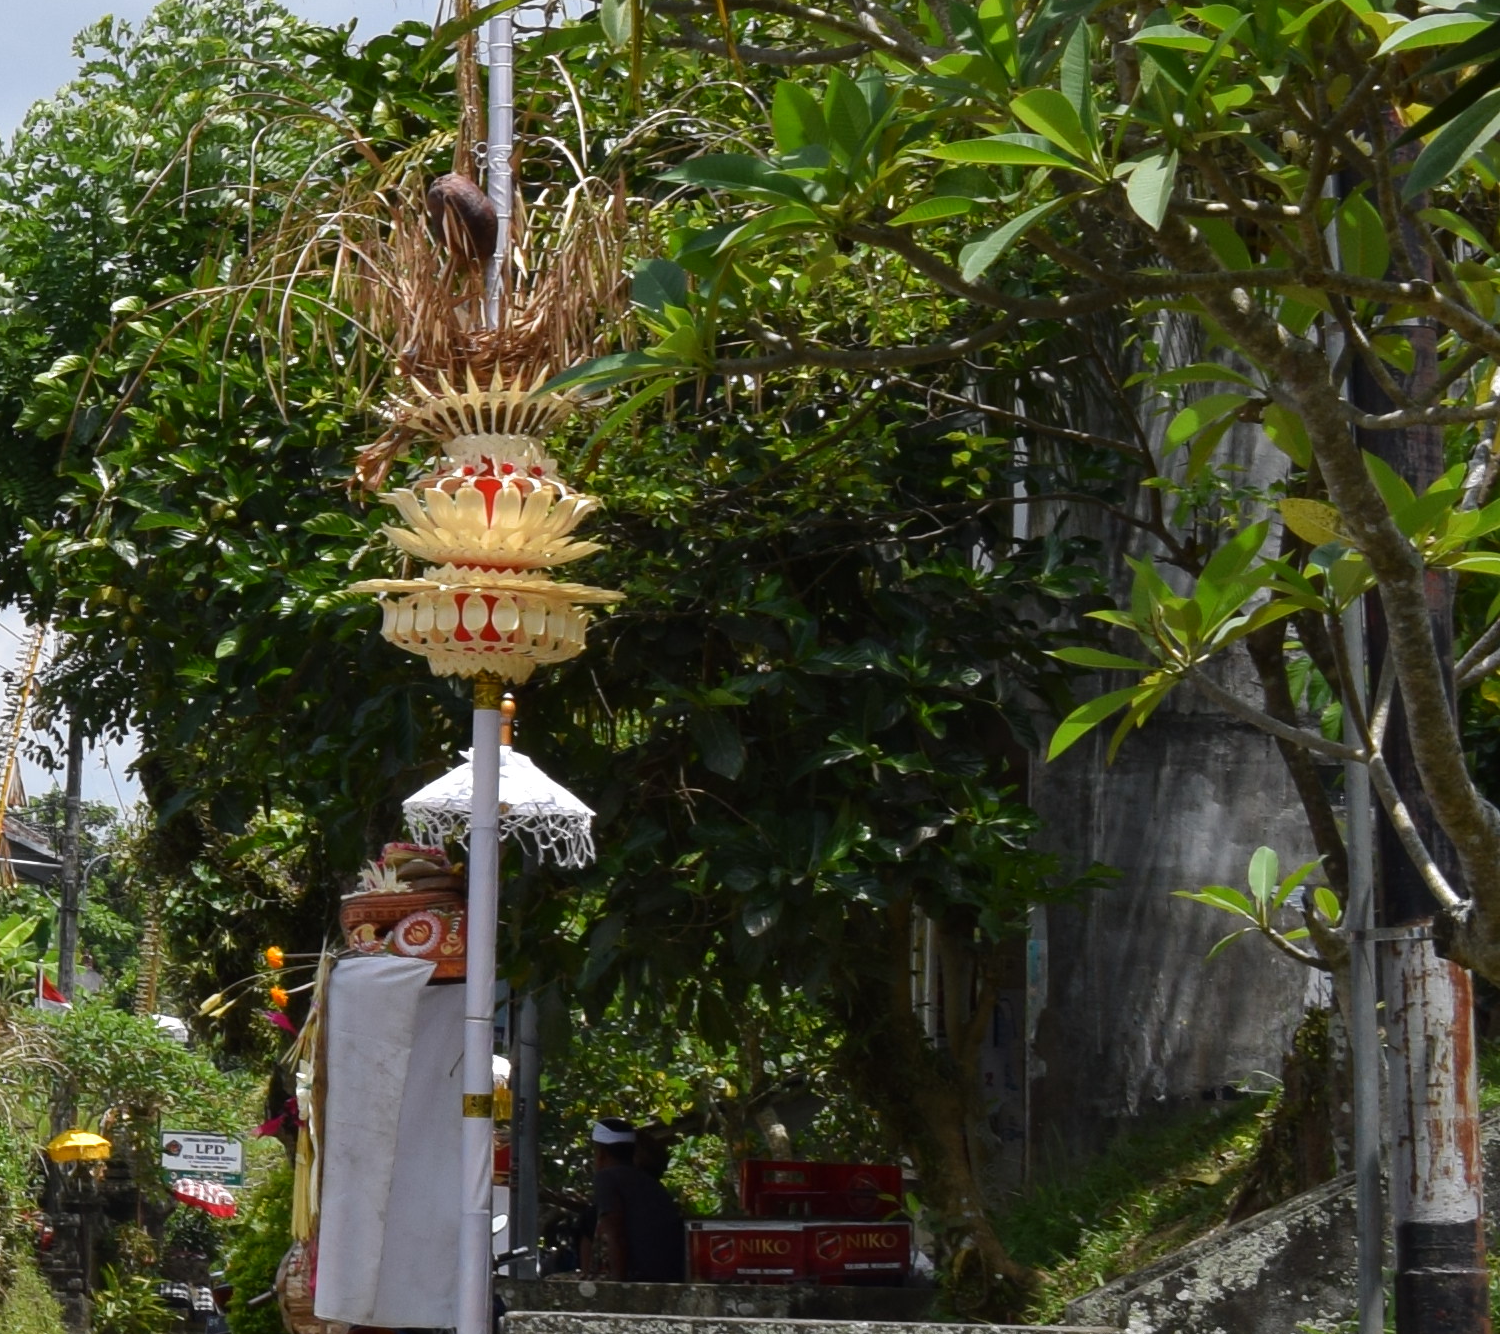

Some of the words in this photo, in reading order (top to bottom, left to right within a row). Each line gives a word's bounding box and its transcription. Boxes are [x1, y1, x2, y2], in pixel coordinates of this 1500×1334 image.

[195, 1143, 226, 1155] LPD
[739, 1238, 791, 1255] NIKO
[845, 1232, 898, 1249] NIKO
